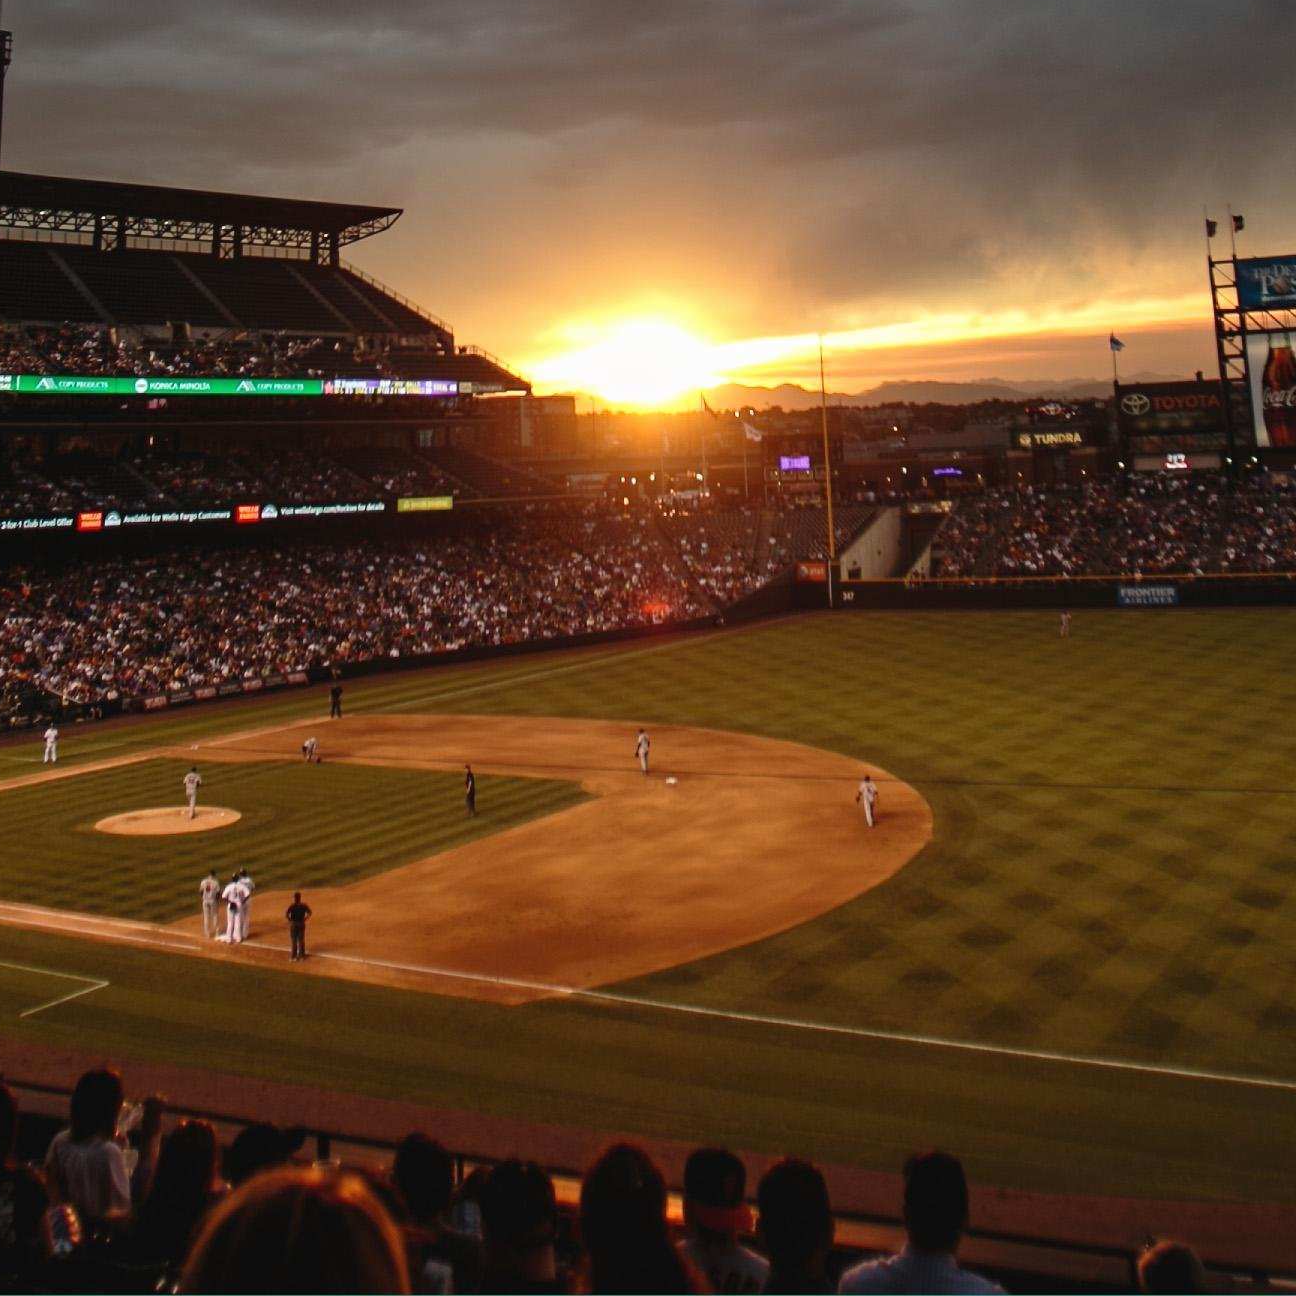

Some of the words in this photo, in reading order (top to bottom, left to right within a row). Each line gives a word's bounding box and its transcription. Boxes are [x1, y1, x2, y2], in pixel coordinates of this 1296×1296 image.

[78, 381, 108, 389] PRODUCTS
[149, 382, 178, 391] KONICA
[179, 382, 211, 391] MINOLTA
[274, 383, 304, 391] PRODUCTS
[1151, 393, 1222, 411] TOYOTA
[1033, 432, 1083, 444] TUNDRA
[151, 512, 161, 522] for
[162, 512, 179, 521] Wells
[179, 512, 197, 522] Fargo
[198, 510, 231, 520] Customers
[23, 519, 38, 528] Club
[39, 519, 56, 527] Level
[56, 518, 73, 527] Offer
[1120, 587, 1176, 597] FRONTIER
[1124, 596, 1175, 605] AIRLINES
